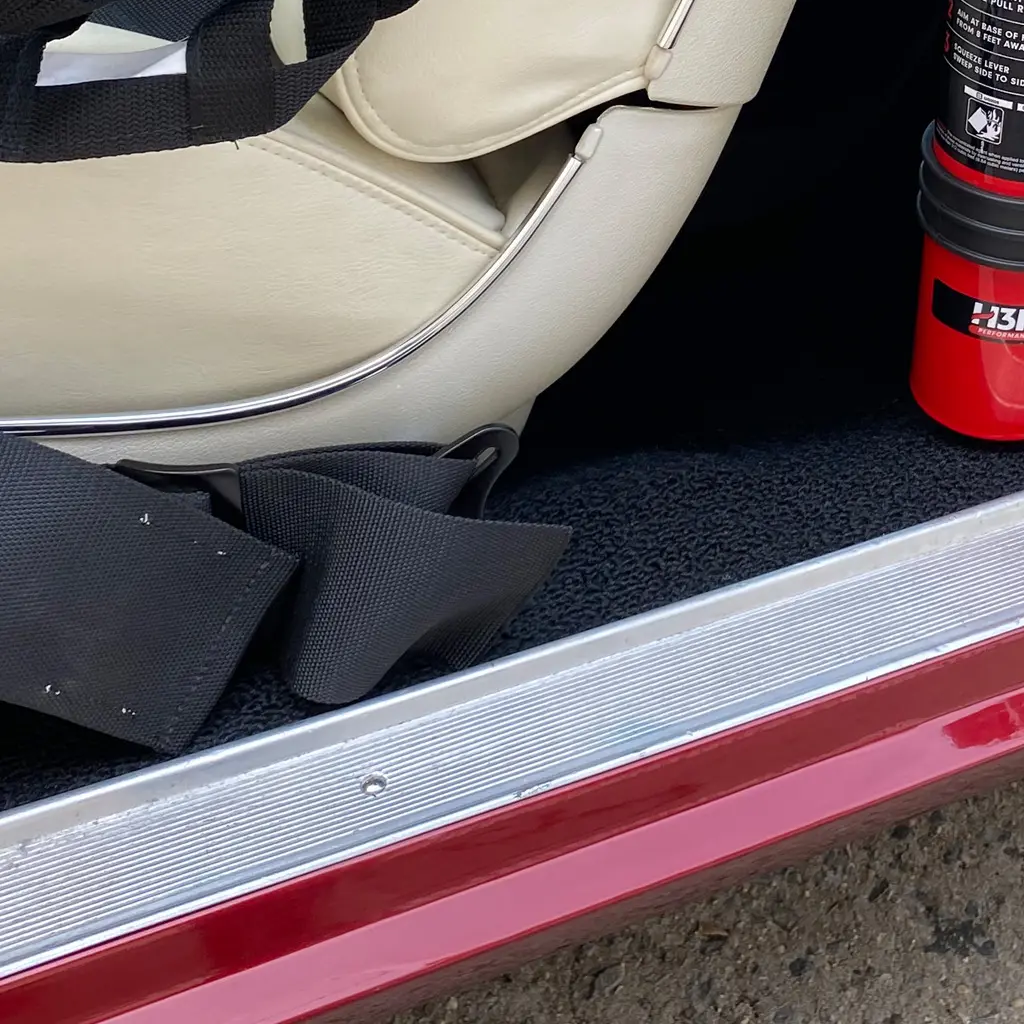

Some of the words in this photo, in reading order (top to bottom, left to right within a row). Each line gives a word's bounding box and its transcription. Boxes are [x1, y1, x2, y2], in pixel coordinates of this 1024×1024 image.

[956, 18, 974, 35] FROM
[976, 29, 980, 37] 8
[983, 34, 1002, 46] FEET
[957, 8, 969, 20] AIM
[970, 18, 980, 27] AT
[982, 23, 1002, 36] BASE
[1005, 31, 1018, 40] OF
[953, 52, 972, 70] SWEEP
[974, 65, 992, 78] SIDE
[995, 73, 1008, 83] TO
[954, 42, 982, 64] SQUEEZE
[984, 60, 1010, 74] LEVER
